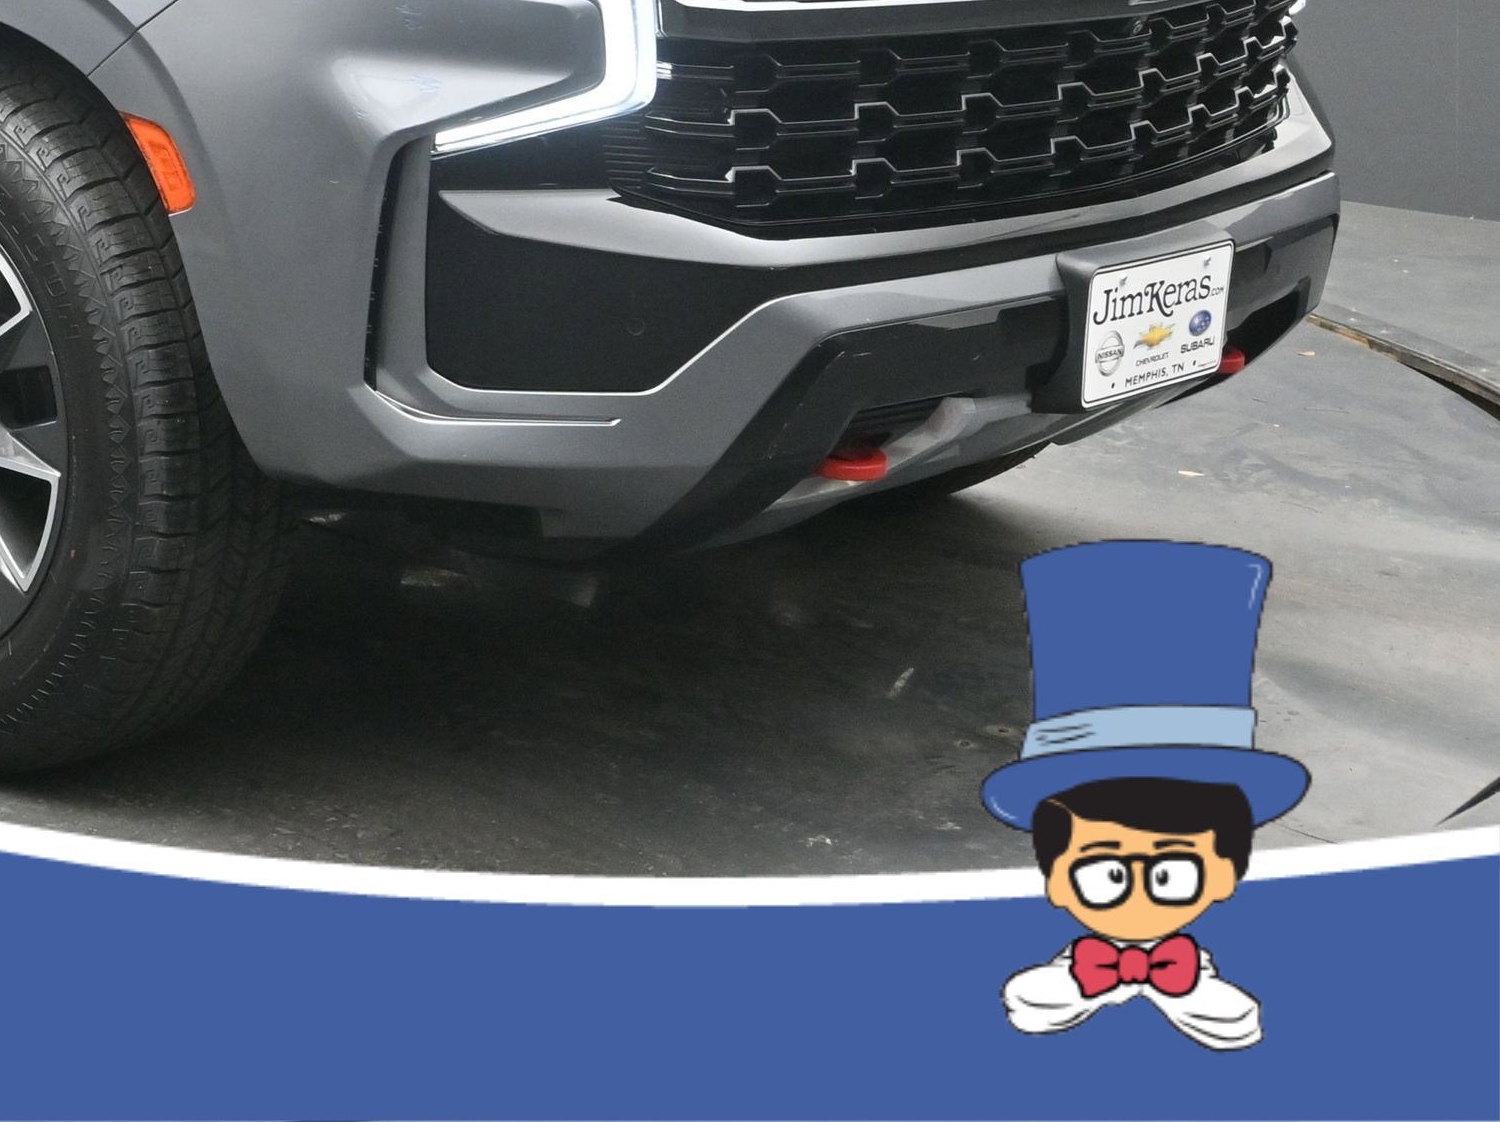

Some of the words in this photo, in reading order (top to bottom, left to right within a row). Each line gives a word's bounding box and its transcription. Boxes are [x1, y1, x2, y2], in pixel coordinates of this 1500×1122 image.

[1180, 337, 1214, 354] SUBARU
[1097, 348, 1122, 359] NISSAN
[1135, 352, 1169, 366] CHEVROLET
[1125, 367, 1168, 387] MEMPHIS,
[1172, 363, 1185, 374] TN
